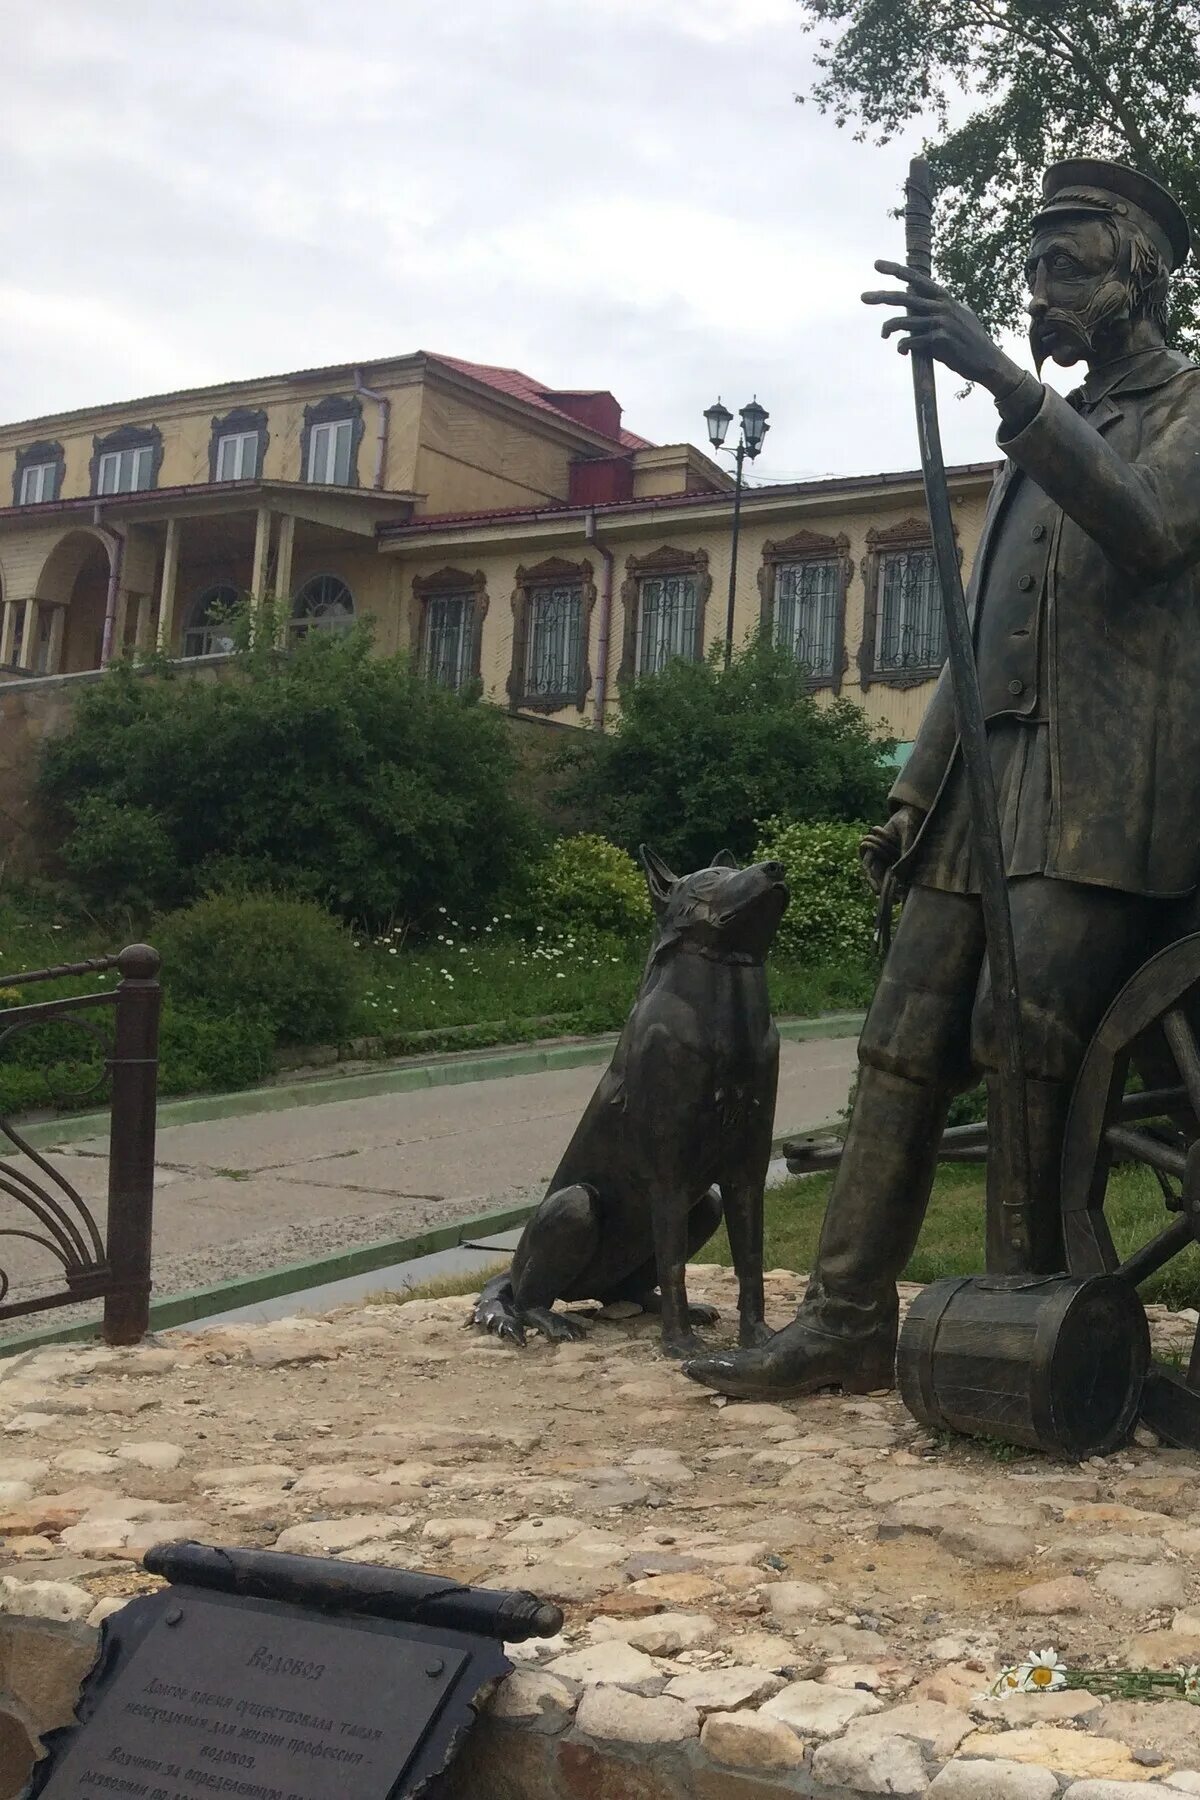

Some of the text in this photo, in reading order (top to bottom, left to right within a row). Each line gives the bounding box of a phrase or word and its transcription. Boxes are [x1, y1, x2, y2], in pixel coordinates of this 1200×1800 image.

[245, 1645, 327, 1681] Водовоз
[142, 1677, 385, 1740] Долгое время существовала такая
[124, 1701, 209, 1730] необходимая
[207, 1720, 237, 1736] для
[237, 1727, 285, 1748] жизни
[287, 1739, 364, 1768] профессия
[105, 1745, 163, 1772] Возчики
[163, 1763, 182, 1779] за
[79, 1769, 151, 1798] развозили
